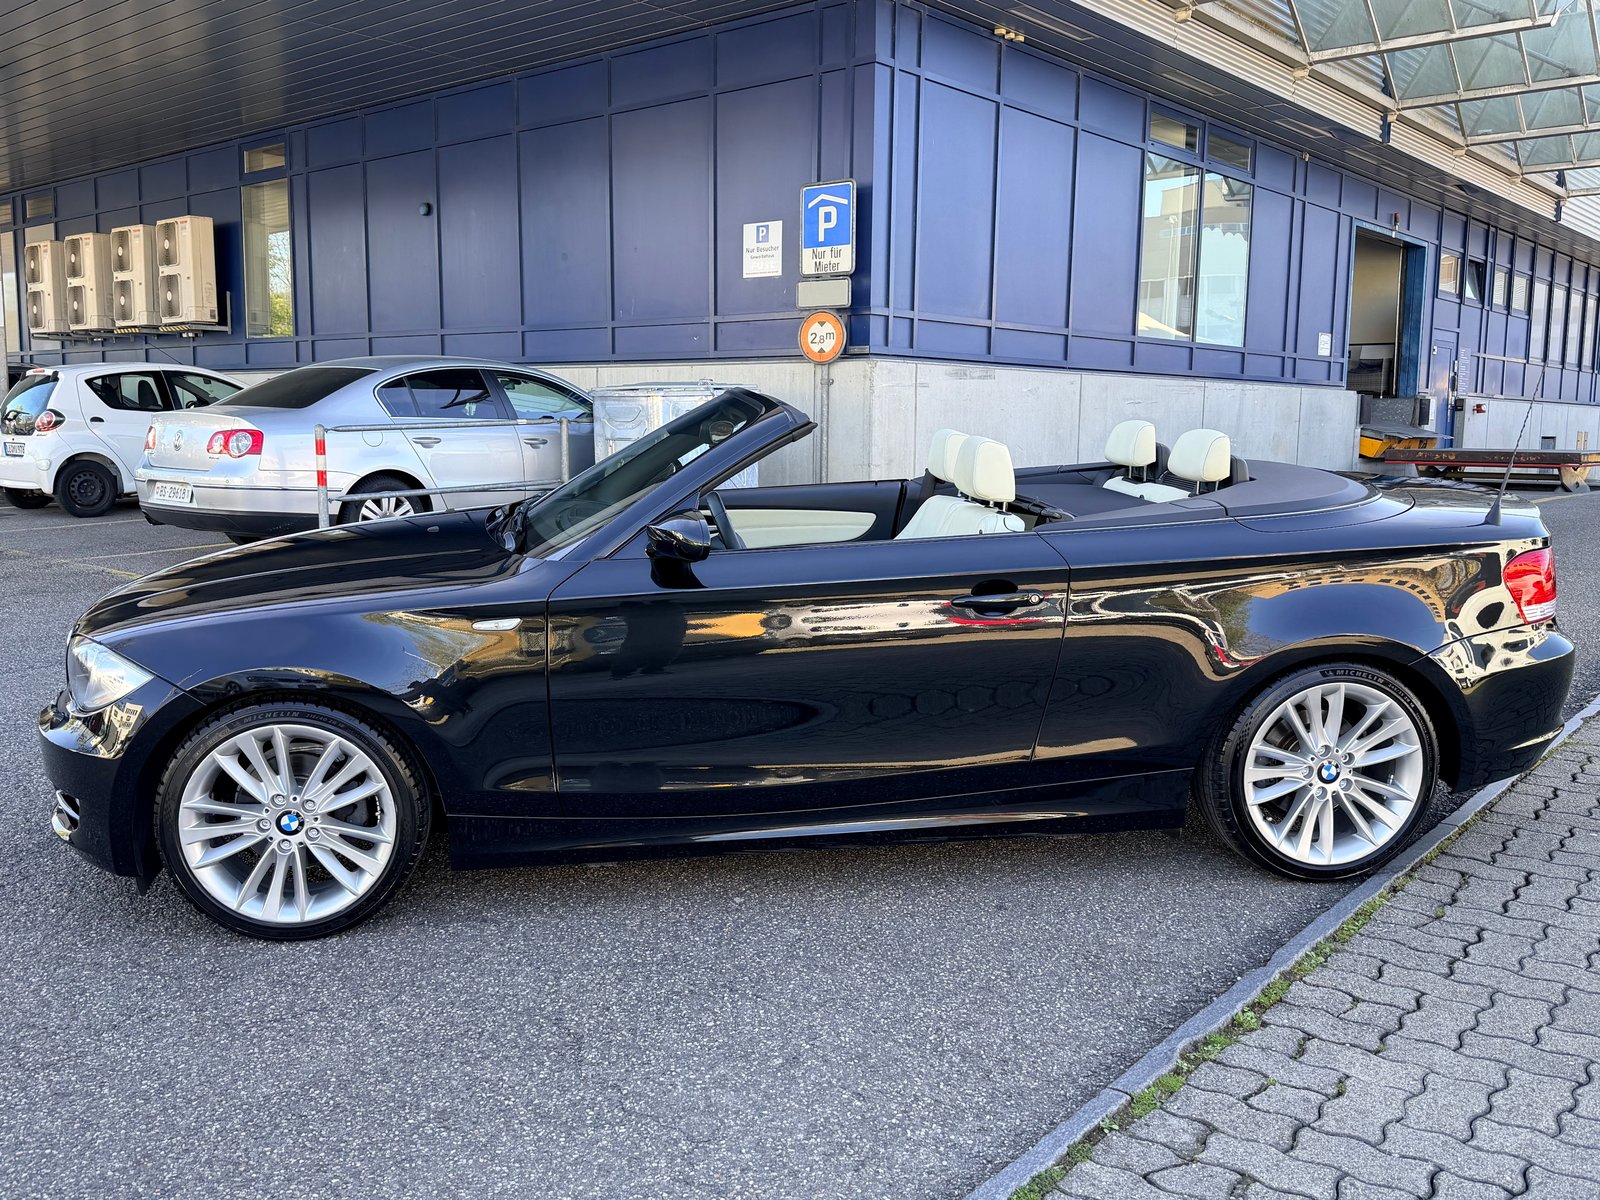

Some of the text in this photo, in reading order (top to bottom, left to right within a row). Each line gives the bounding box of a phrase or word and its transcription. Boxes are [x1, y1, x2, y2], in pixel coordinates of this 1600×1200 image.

[818, 205, 837, 242] P
[759, 226, 767, 242] P
[756, 245, 779, 253] Besucher
[812, 247, 842, 260] Nur für
[814, 260, 840, 273] Mieter
[1336, 669, 1384, 684] MICHELIN
[243, 710, 300, 723] MICHELIN
